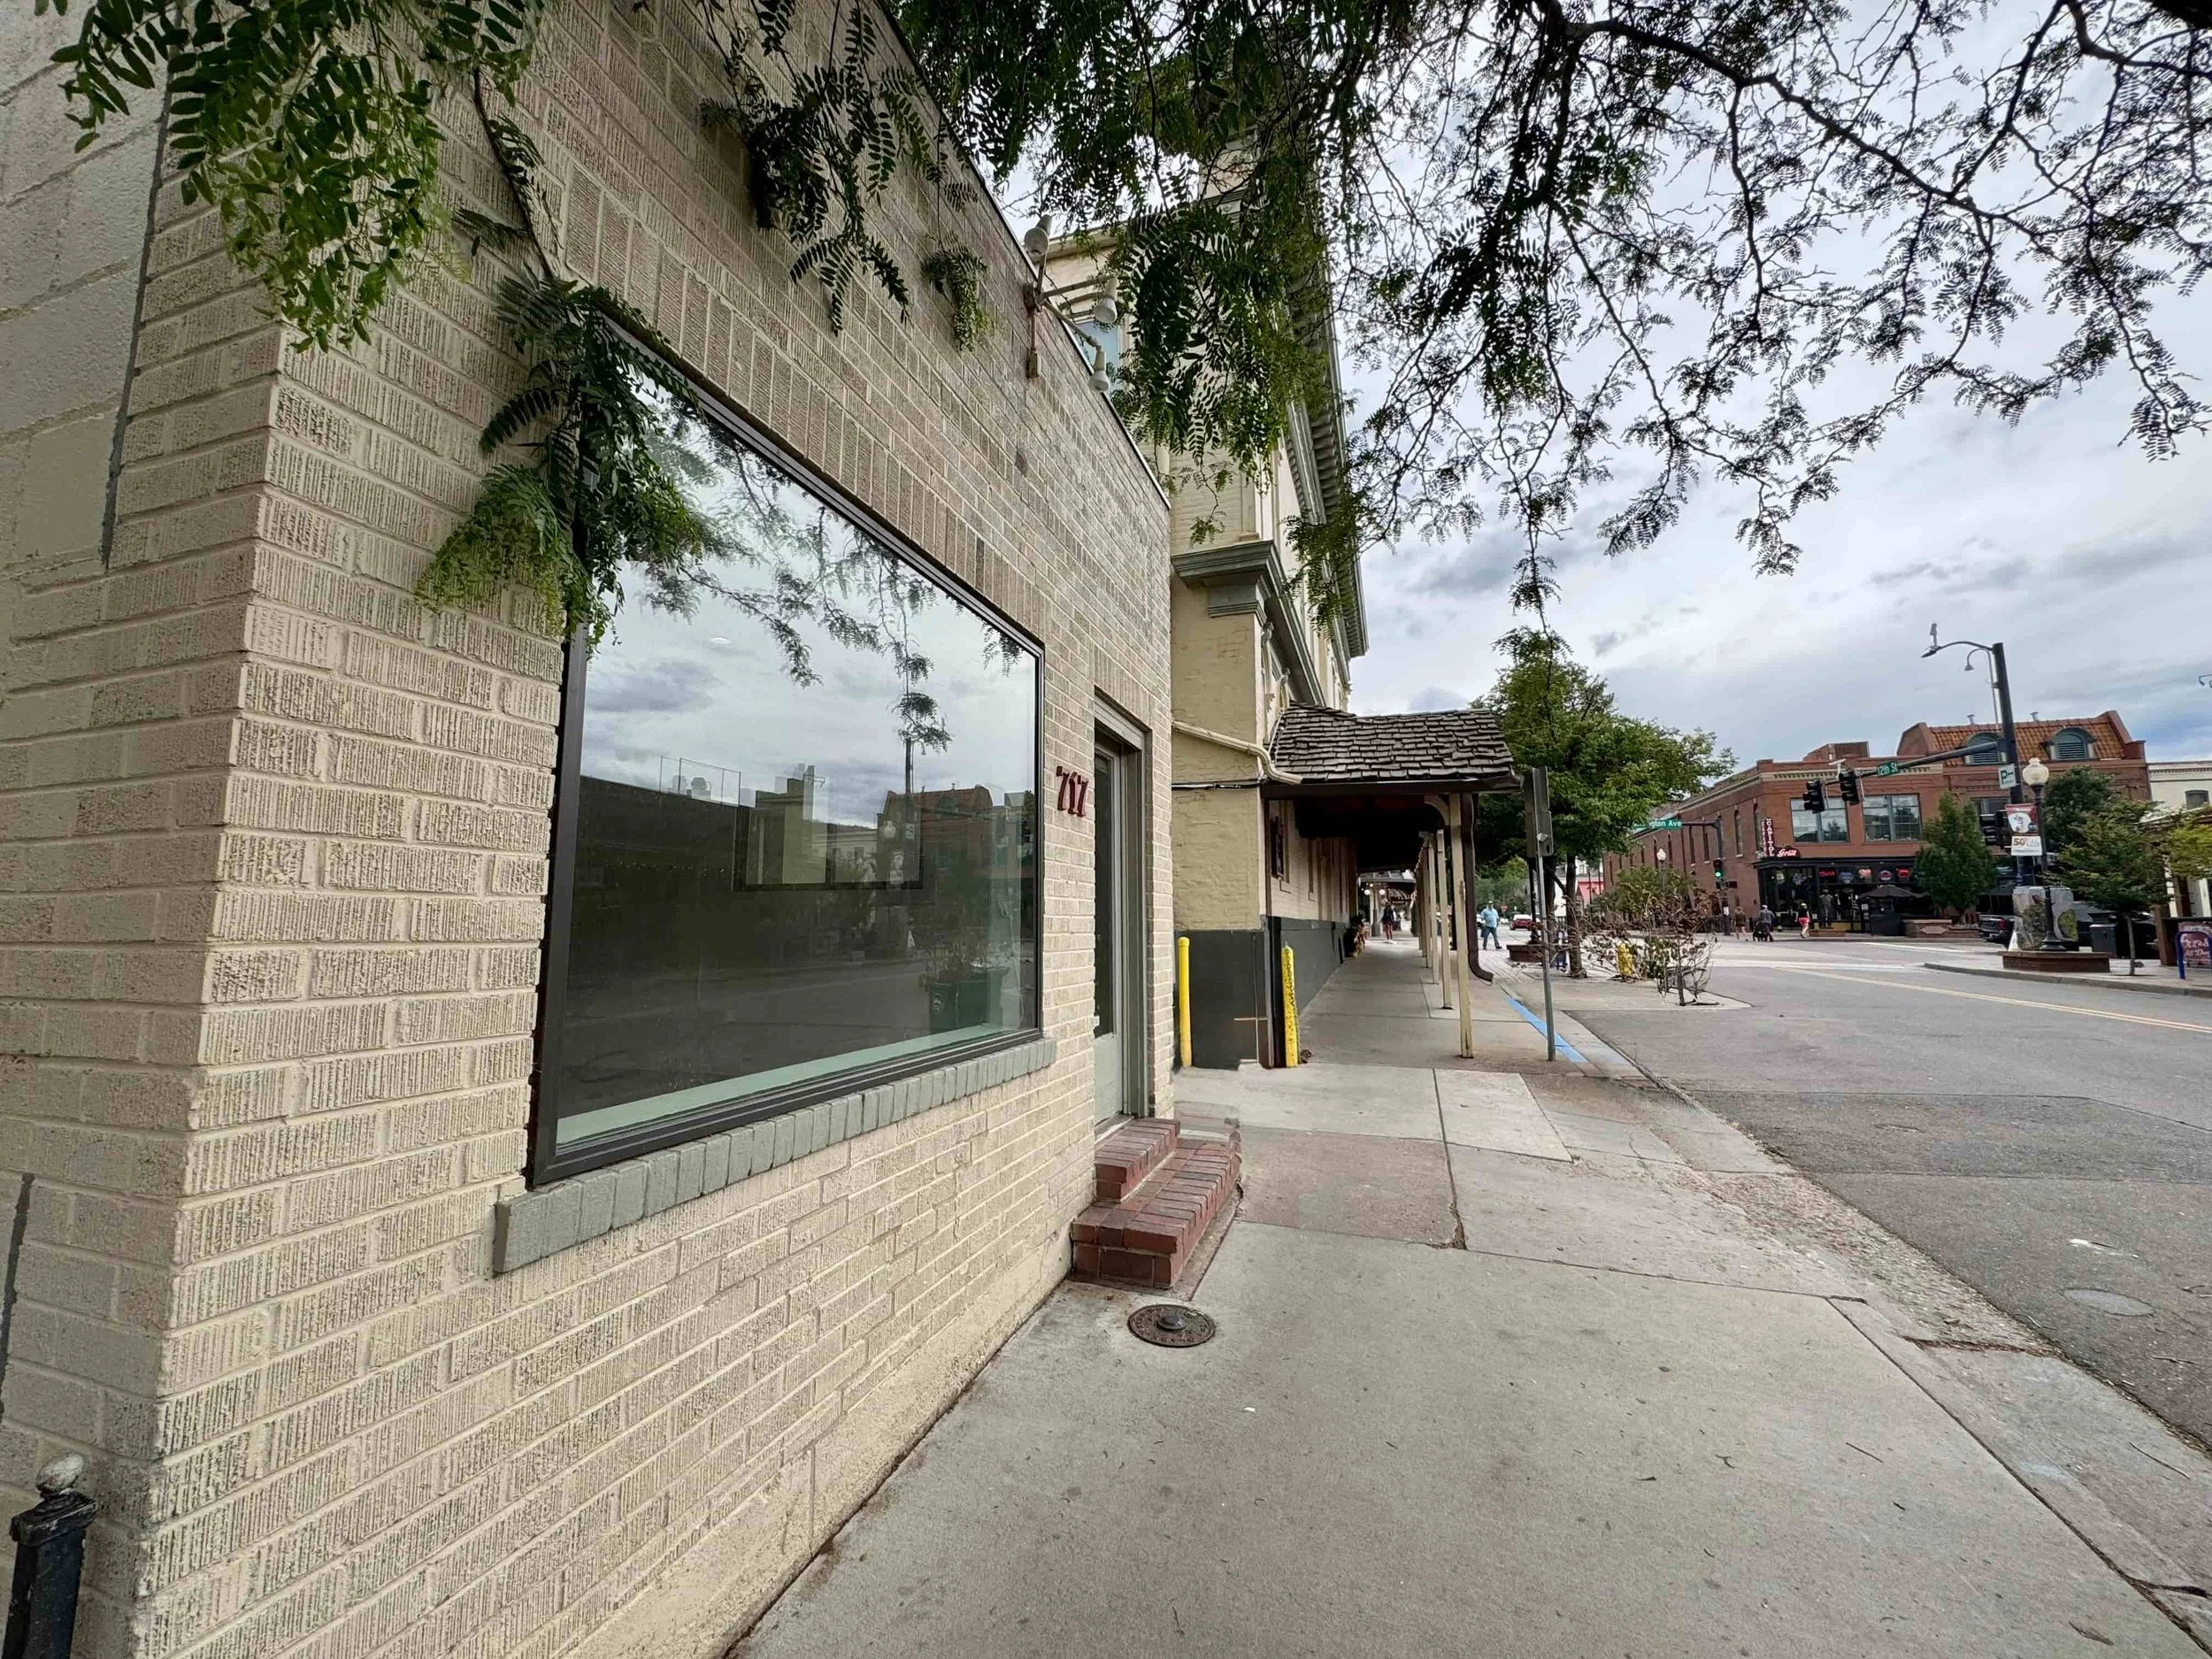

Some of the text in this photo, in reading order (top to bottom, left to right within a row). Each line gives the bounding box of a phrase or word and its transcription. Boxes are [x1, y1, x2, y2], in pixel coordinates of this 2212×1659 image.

[1878, 762, 1898, 776] 12th St
[1056, 766, 1089, 818] 717
[1766, 820, 1775, 856] CAPITOL
